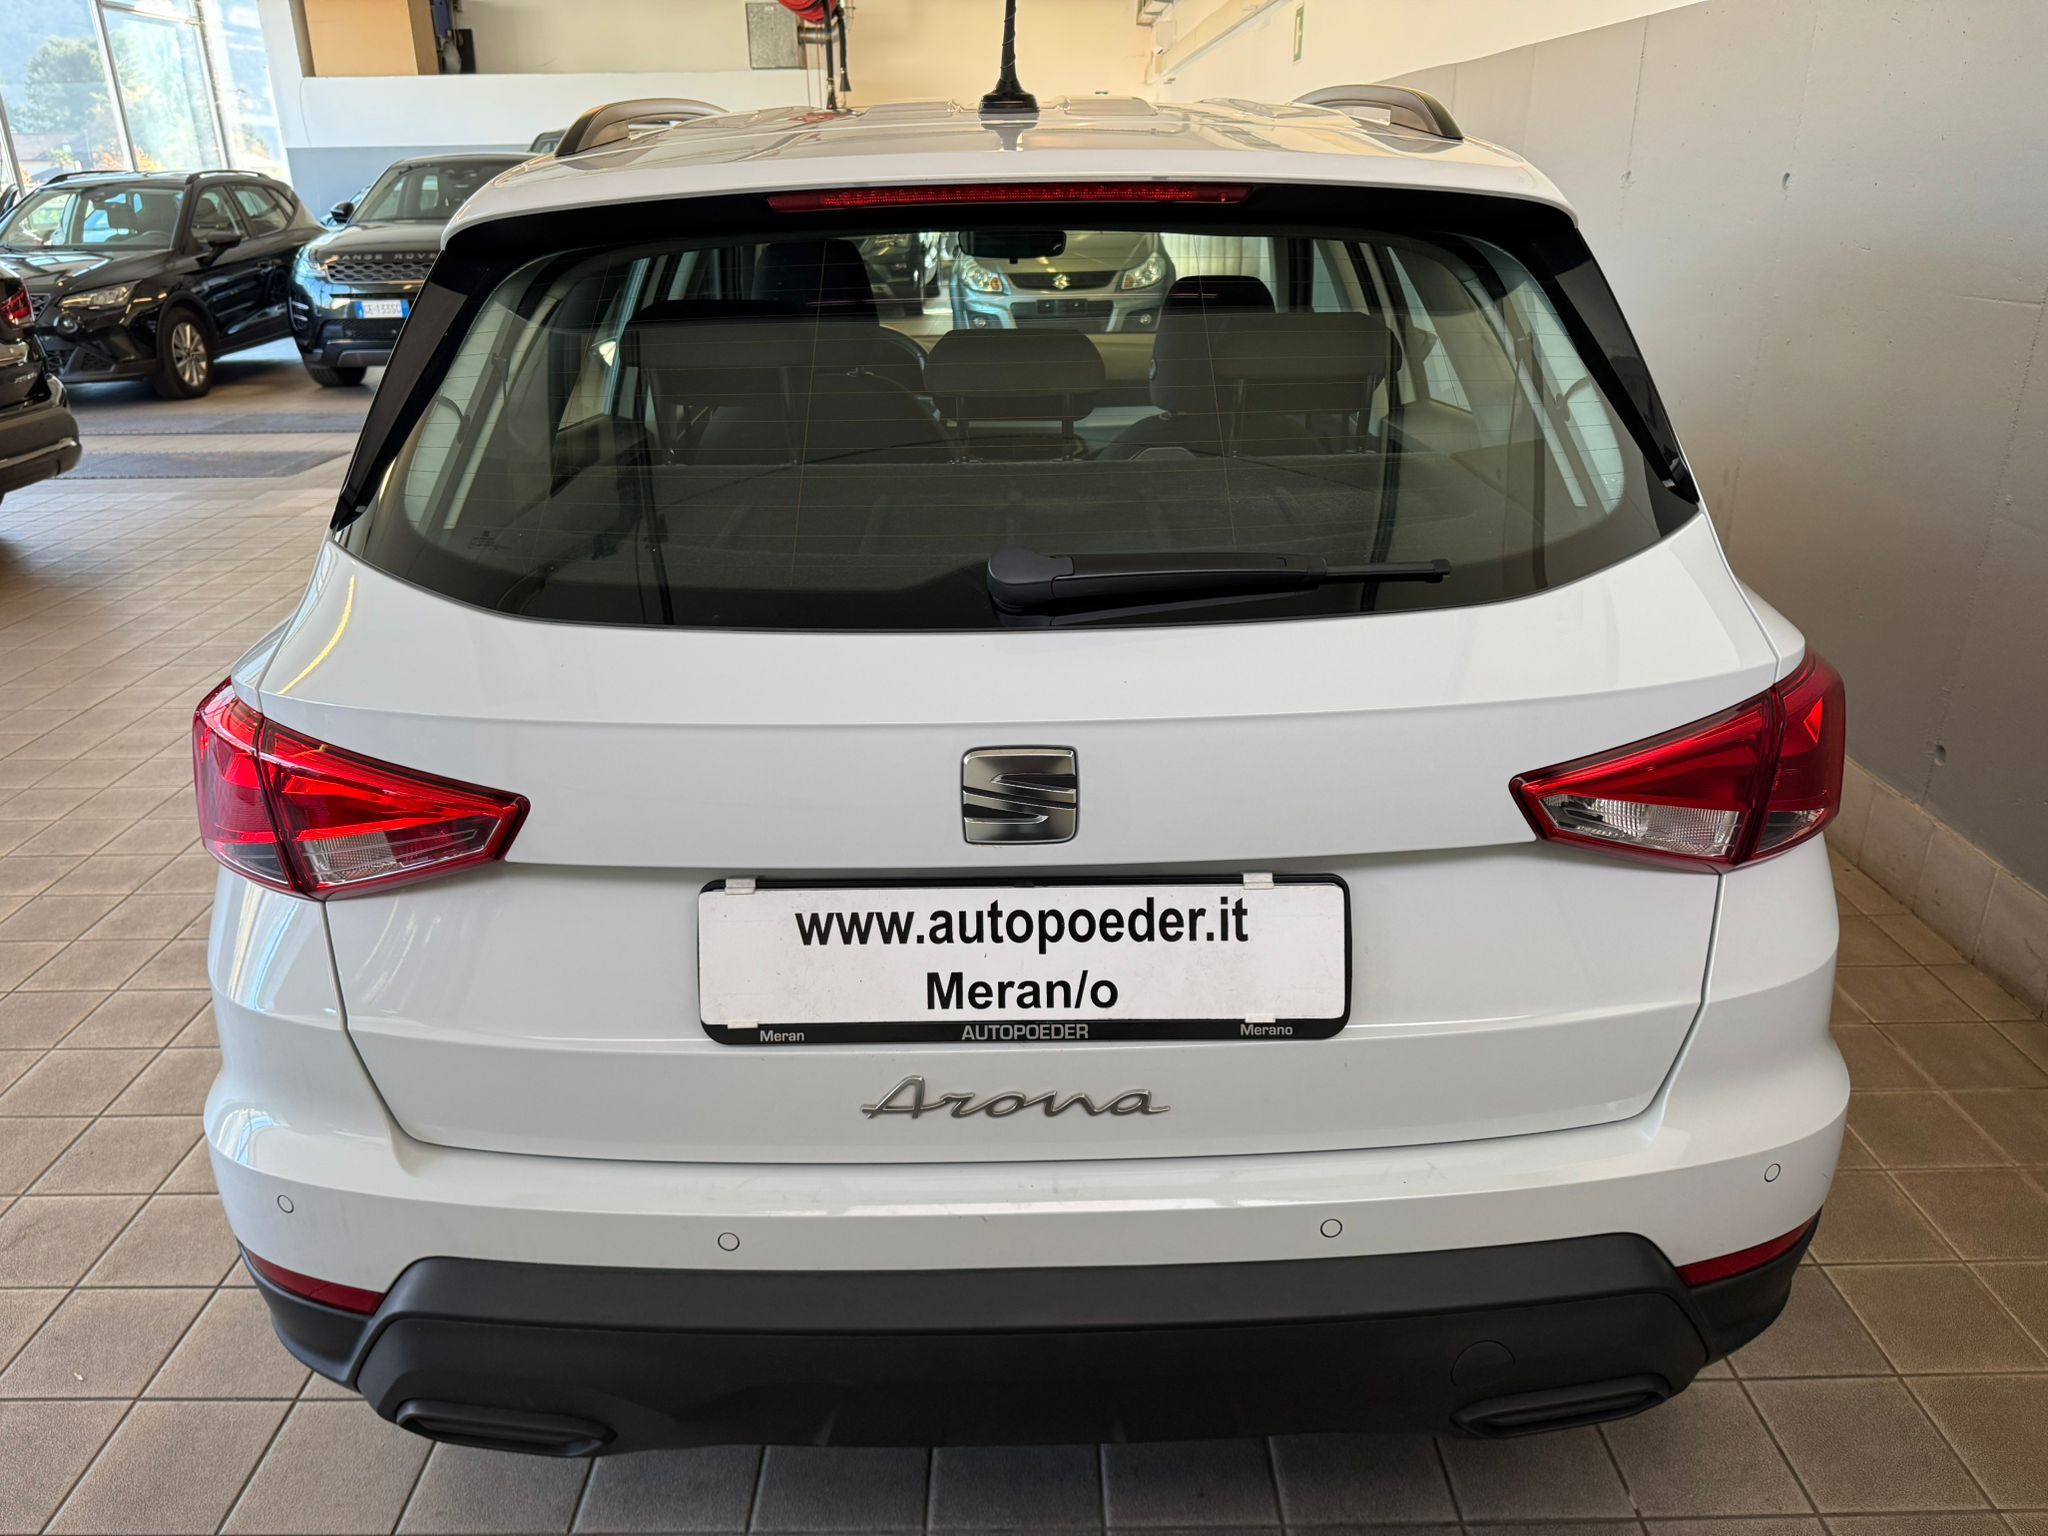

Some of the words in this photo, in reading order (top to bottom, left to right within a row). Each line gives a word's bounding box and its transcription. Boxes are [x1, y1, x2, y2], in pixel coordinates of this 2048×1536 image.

[394, 252, 437, 260] ROVE
[794, 896, 1249, 954] www.autopoeder.it
[926, 970, 1118, 1010] Meran/o
[759, 1030, 805, 1042] Meran
[961, 1023, 1089, 1040] AUTOPOEDER
[1240, 1024, 1293, 1036] Merano
[861, 1074, 1171, 1119] Arona
